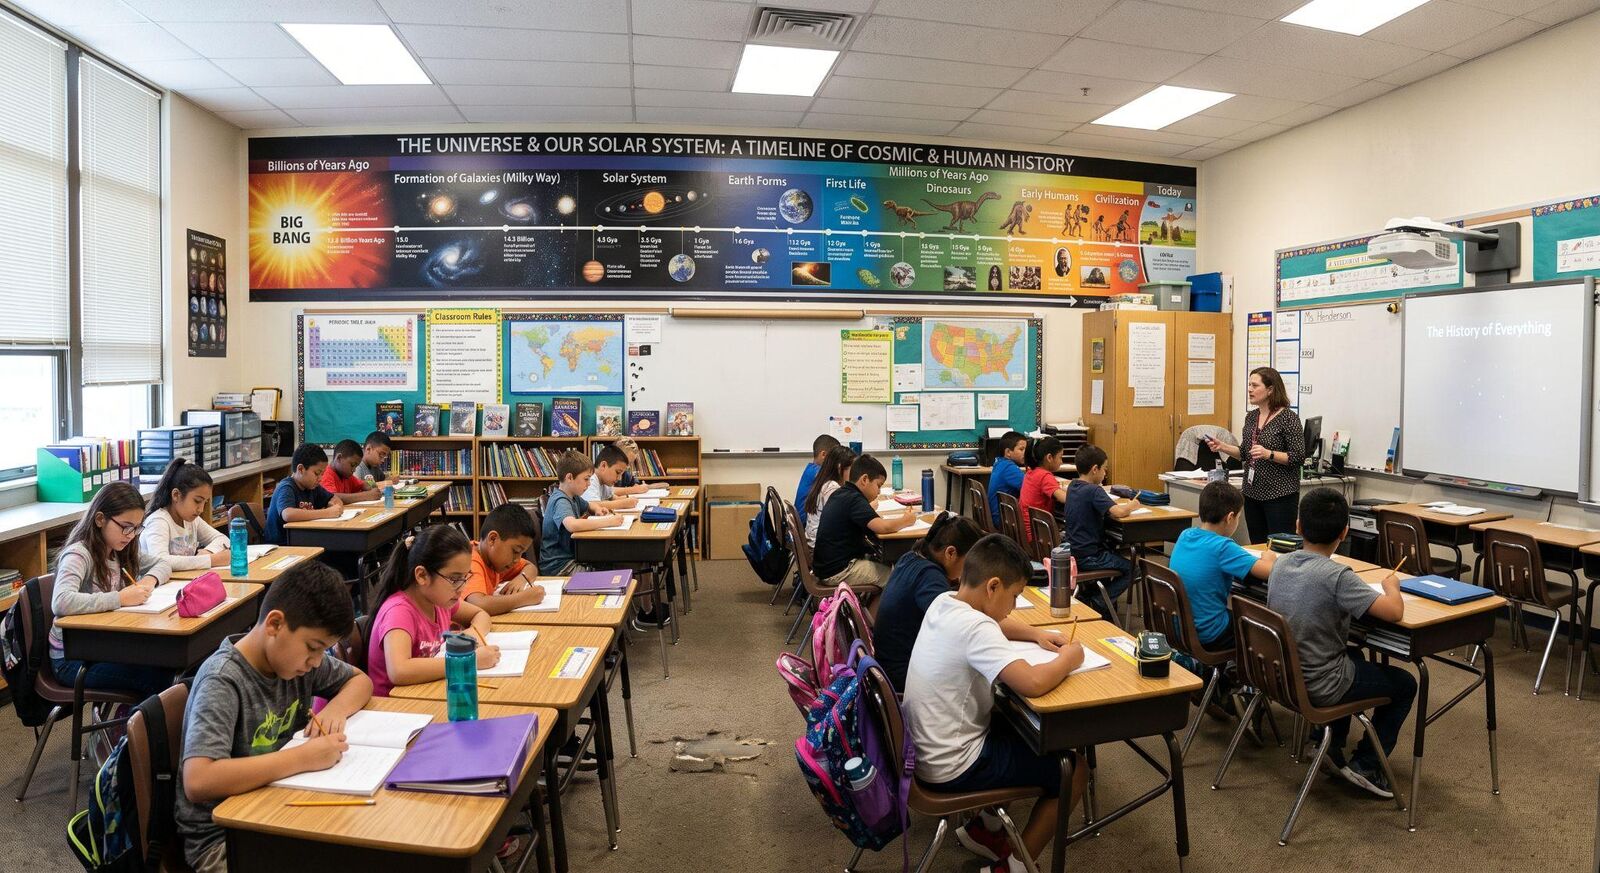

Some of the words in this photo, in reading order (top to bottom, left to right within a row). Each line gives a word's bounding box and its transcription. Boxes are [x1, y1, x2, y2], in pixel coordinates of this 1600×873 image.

[397, 137, 431, 153] THE
[436, 137, 523, 153] UNIVERSE
[527, 137, 540, 152] &
[544, 137, 584, 152] OUR
[588, 137, 647, 153] SOLAR
[651, 138, 725, 155] SYSTEM:
[730, 139, 743, 155] A
[746, 139, 826, 158] TIMELINE
[830, 143, 853, 159] OF
[857, 145, 923, 163] COSMIC
[927, 149, 940, 164] &
[944, 150, 1006, 169] HUMAN
[1010, 155, 1075, 173] HISTORY
[267, 160, 304, 171] Billions
[306, 160, 318, 171] of
[319, 160, 346, 170] Years
[348, 159, 370, 171] Ago
[394, 173, 444, 184] Formation
[446, 173, 457, 183] of
[459, 172, 501, 183] Galaxies
[502, 172, 534, 185] (Milky
[535, 172, 561, 185] Way)
[602, 172, 629, 183] Solar
[630, 173, 667, 186] System
[728, 175, 755, 186] Earth
[756, 176, 787, 187] Forms
[889, 166, 928, 178] Millions
[929, 168, 941, 179] of
[941, 169, 968, 181] Years
[969, 171, 989, 183] Ago
[826, 178, 847, 189] First
[848, 179, 867, 190] Life
[926, 183, 972, 195] Dinosaurs
[1021, 188, 1042, 201] Early
[1044, 190, 1079, 202] Humans
[1157, 185, 1182, 198] Today
[1095, 194, 1140, 207] Civilization
[280, 216, 303, 229] BIG
[273, 232, 311, 244] BANG
[373, 237, 385, 245] Ago
[434, 312, 471, 321] Classroom
[473, 312, 492, 321] Rules
[1317, 310, 1352, 321] Henderson
[1426, 325, 1444, 338] The
[1446, 324, 1480, 339] History
[1482, 322, 1494, 336] of
[1495, 320, 1552, 338] Everything
